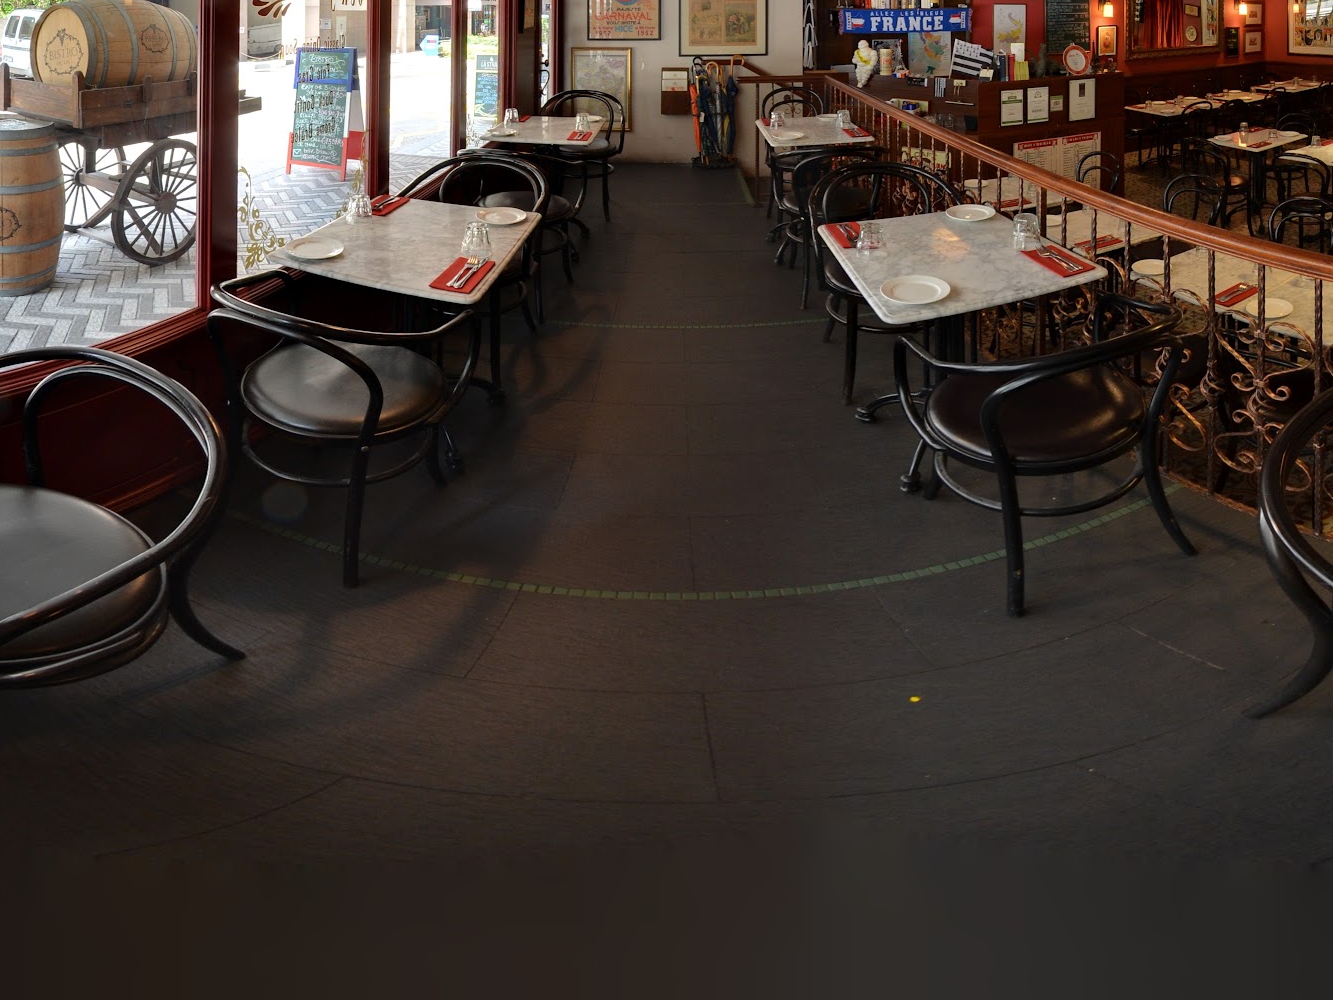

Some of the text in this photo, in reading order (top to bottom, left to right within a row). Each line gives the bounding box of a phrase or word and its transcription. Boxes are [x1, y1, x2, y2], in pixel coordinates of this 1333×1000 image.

[594, 12, 652, 20] CARNAVAL
[870, 16, 944, 32] FRANCE
[49, 47, 78, 60] BISTRO
